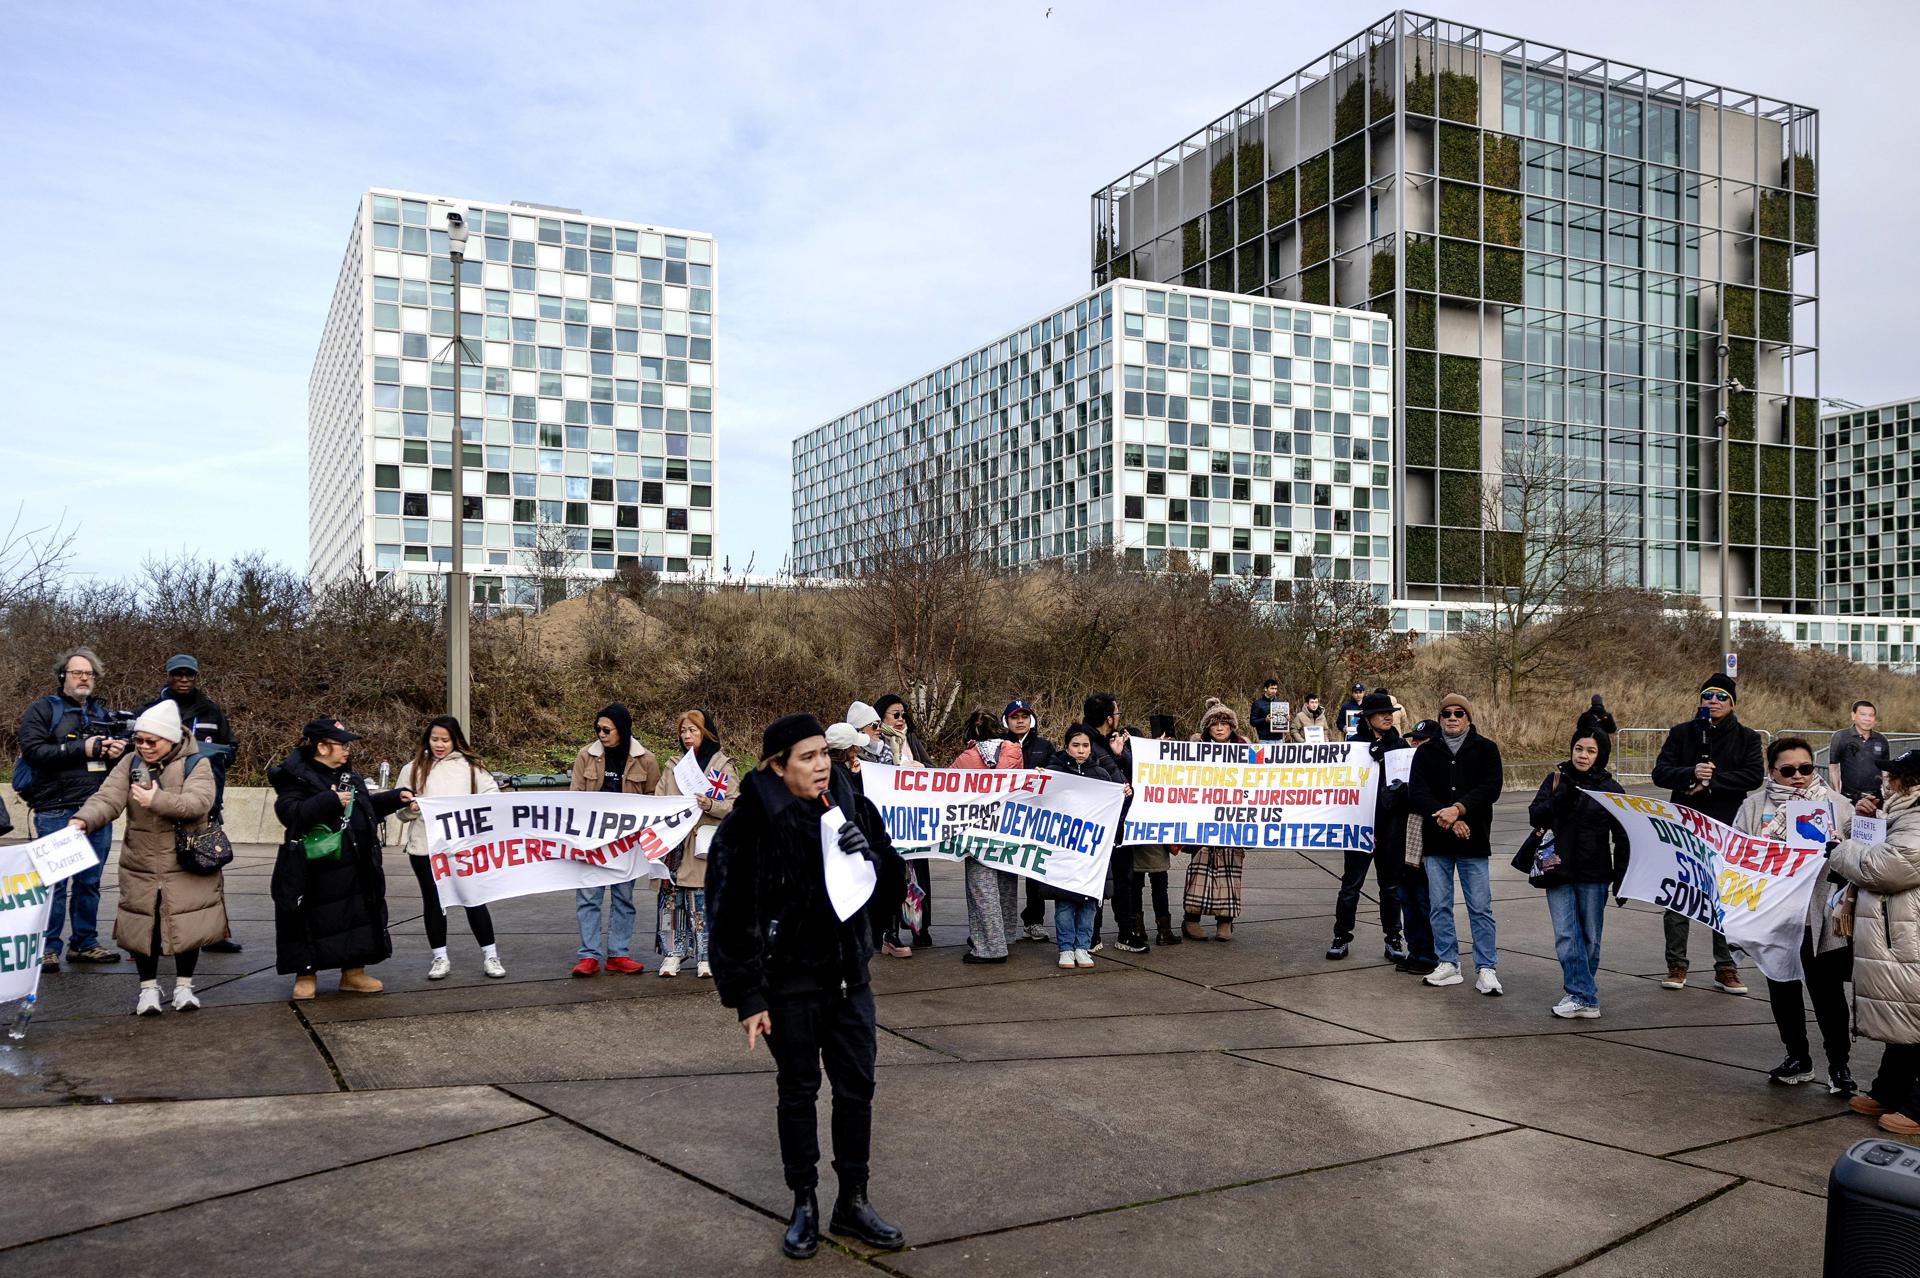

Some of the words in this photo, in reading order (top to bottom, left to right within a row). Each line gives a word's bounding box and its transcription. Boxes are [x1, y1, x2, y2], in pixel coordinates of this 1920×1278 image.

[1160, 742, 1248, 763] PHILIPPINE
[1265, 744, 1351, 764] JUDICIARY
[894, 770, 929, 791] ICC
[931, 772, 960, 792] DO
[963, 773, 1007, 793] NOT
[1008, 774, 1052, 794] LET
[1137, 763, 1238, 787] FUNCTIONS
[1242, 767, 1371, 787] EFFECTIVELY
[1144, 786, 1164, 803] NO
[1168, 788, 1199, 804] ONE
[1248, 789, 1359, 805] JURISDICTION
[436, 806, 493, 840] THE
[882, 805, 940, 841] MONEY
[946, 801, 1001, 821] STAND
[1214, 807, 1257, 822] OVER
[1261, 807, 1282, 822] US
[1000, 801, 1105, 856] DEMOCRACY
[1263, 823, 1374, 852] CITIZENS
[1674, 804, 1819, 877] PRESIDENT
[431, 852, 451, 880] A
[939, 835, 1052, 875] DUTERTE
